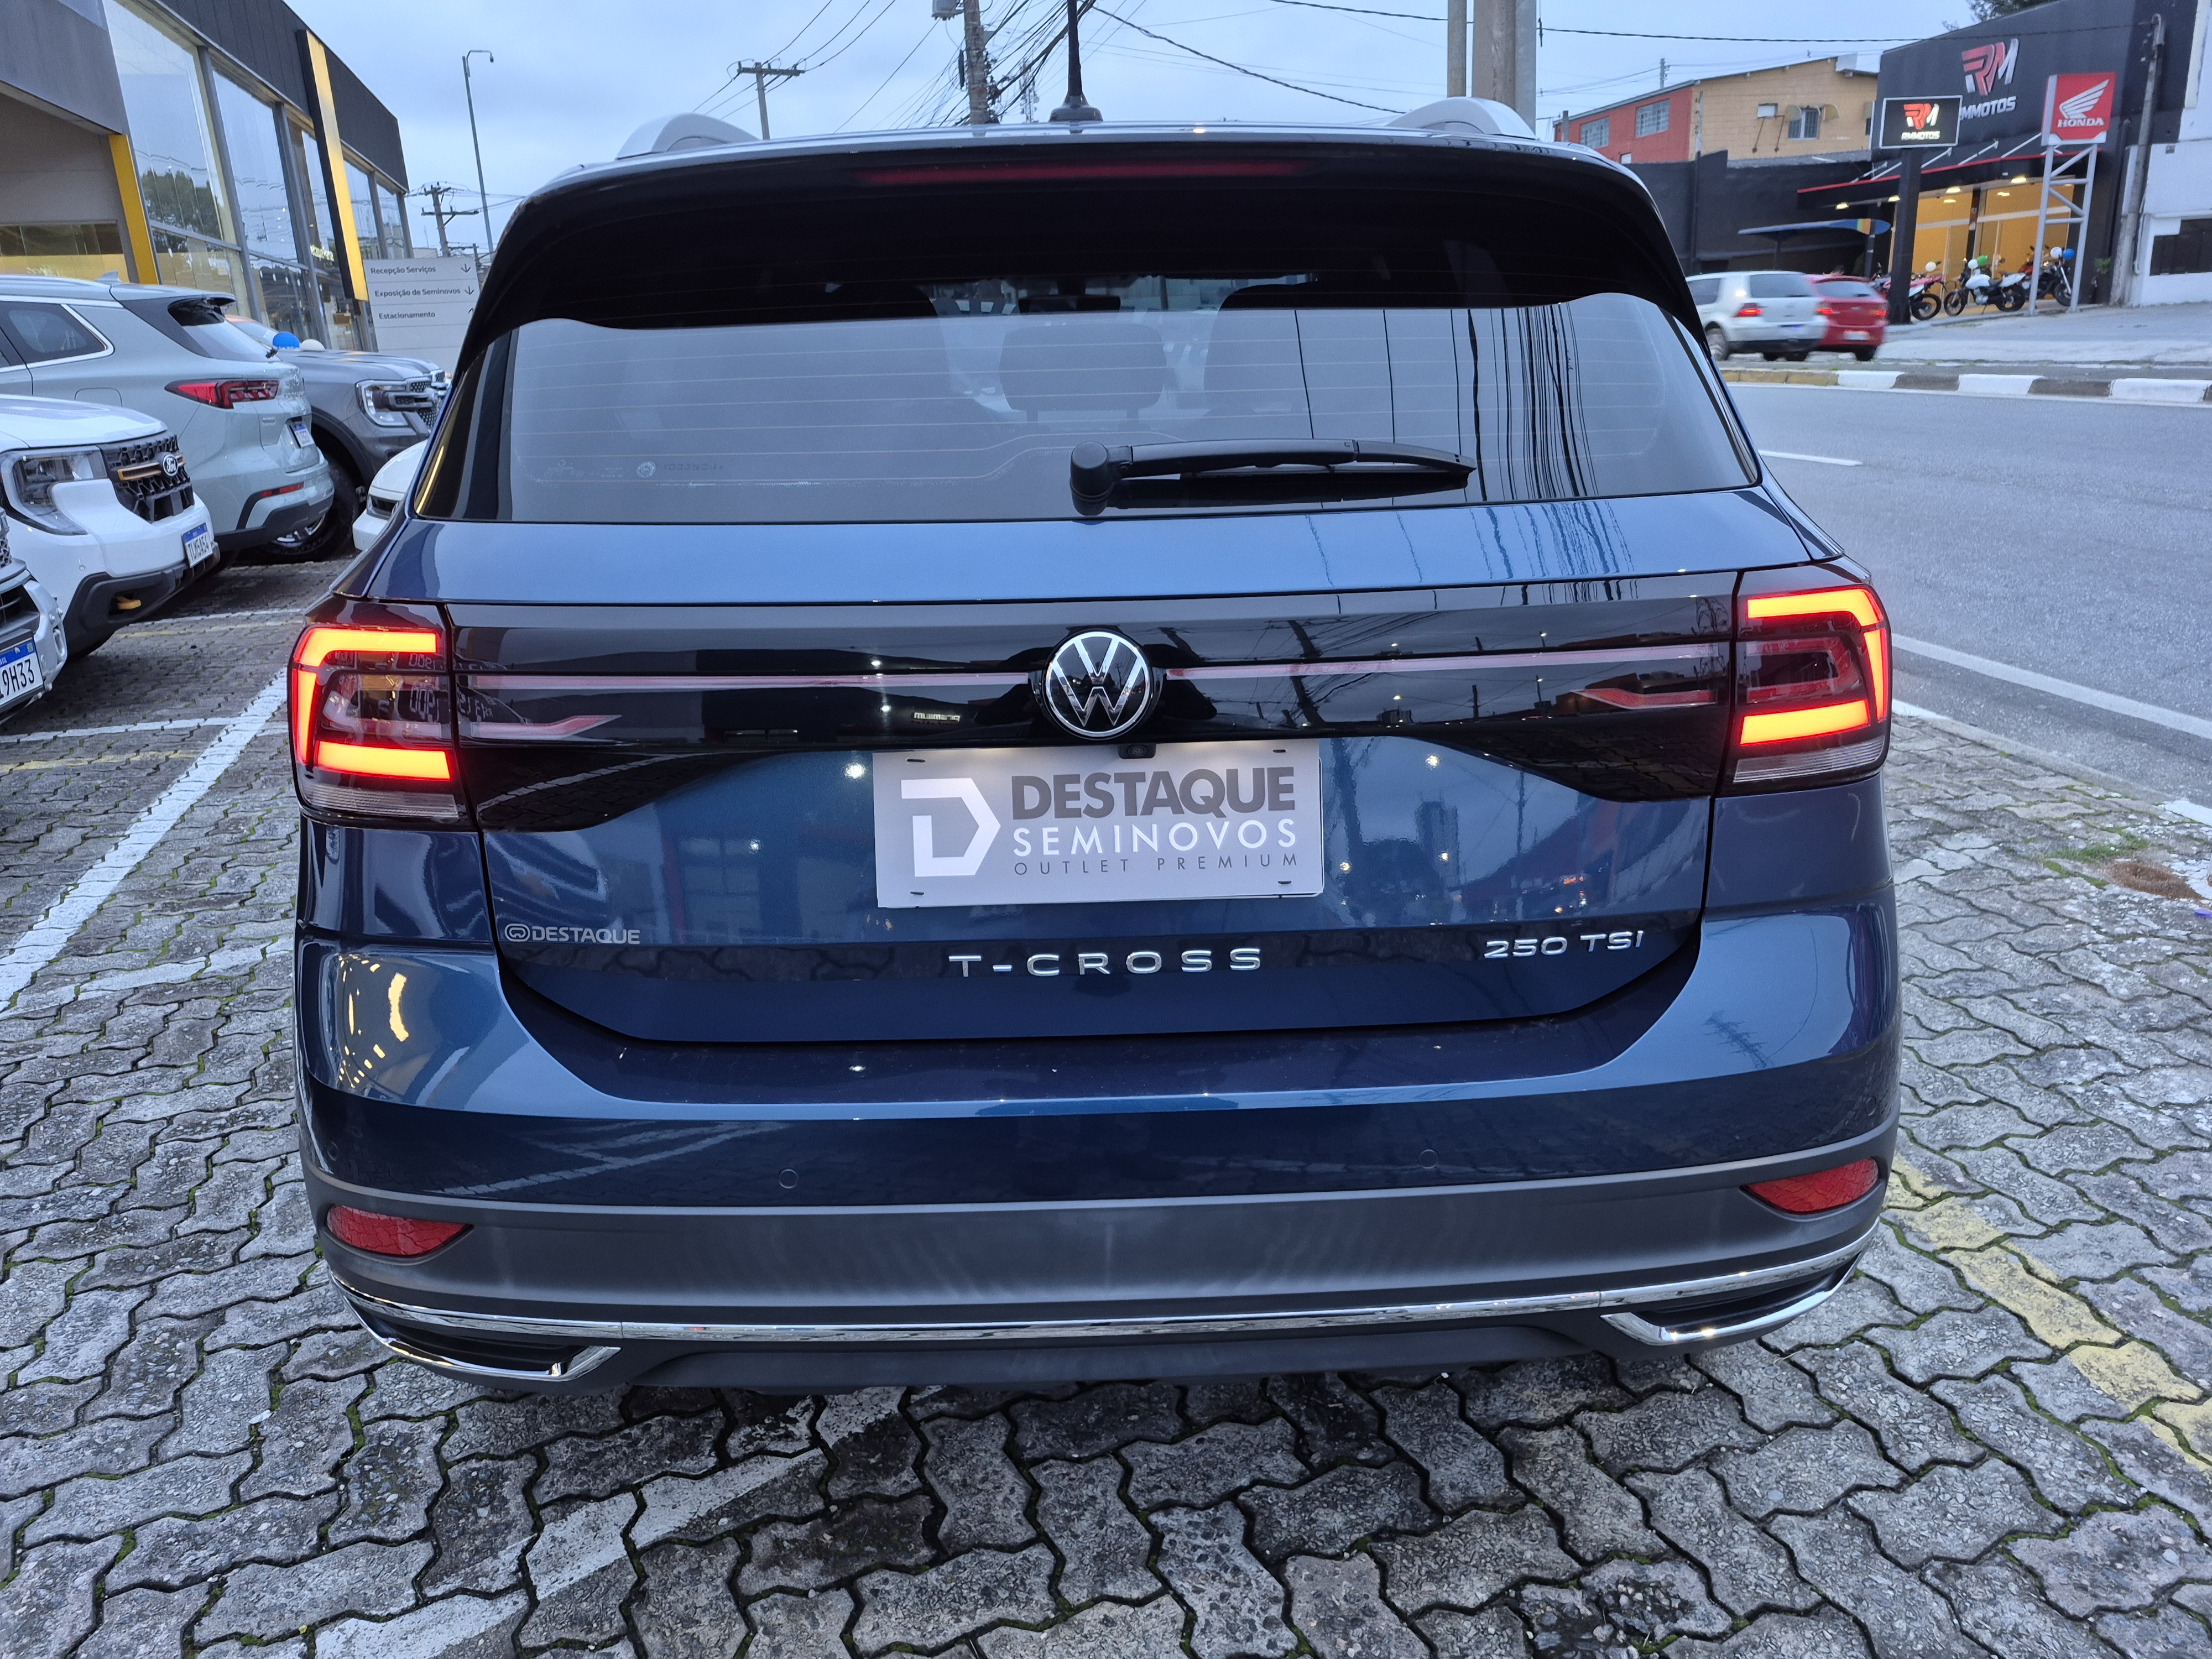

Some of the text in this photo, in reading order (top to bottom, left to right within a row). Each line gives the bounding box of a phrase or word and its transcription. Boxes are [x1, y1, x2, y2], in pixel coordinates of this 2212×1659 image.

[1959, 96, 2017, 121] MMOTOS
[2057, 117, 2104, 128] HONDA
[1901, 131, 1940, 140] RMMOTOS
[371, 266, 436, 275] Recepção Serviços
[374, 289, 411, 298] Exposição
[421, 288, 461, 296] Seminovos
[1011, 766, 1296, 820] DESTAQUE
[1013, 818, 1296, 857] SEMINOVOS
[1014, 852, 1297, 875] OUTLET PREMIUM
[1483, 930, 1644, 958] 250 TSI
[948, 947, 1261, 978] T-CROSS
